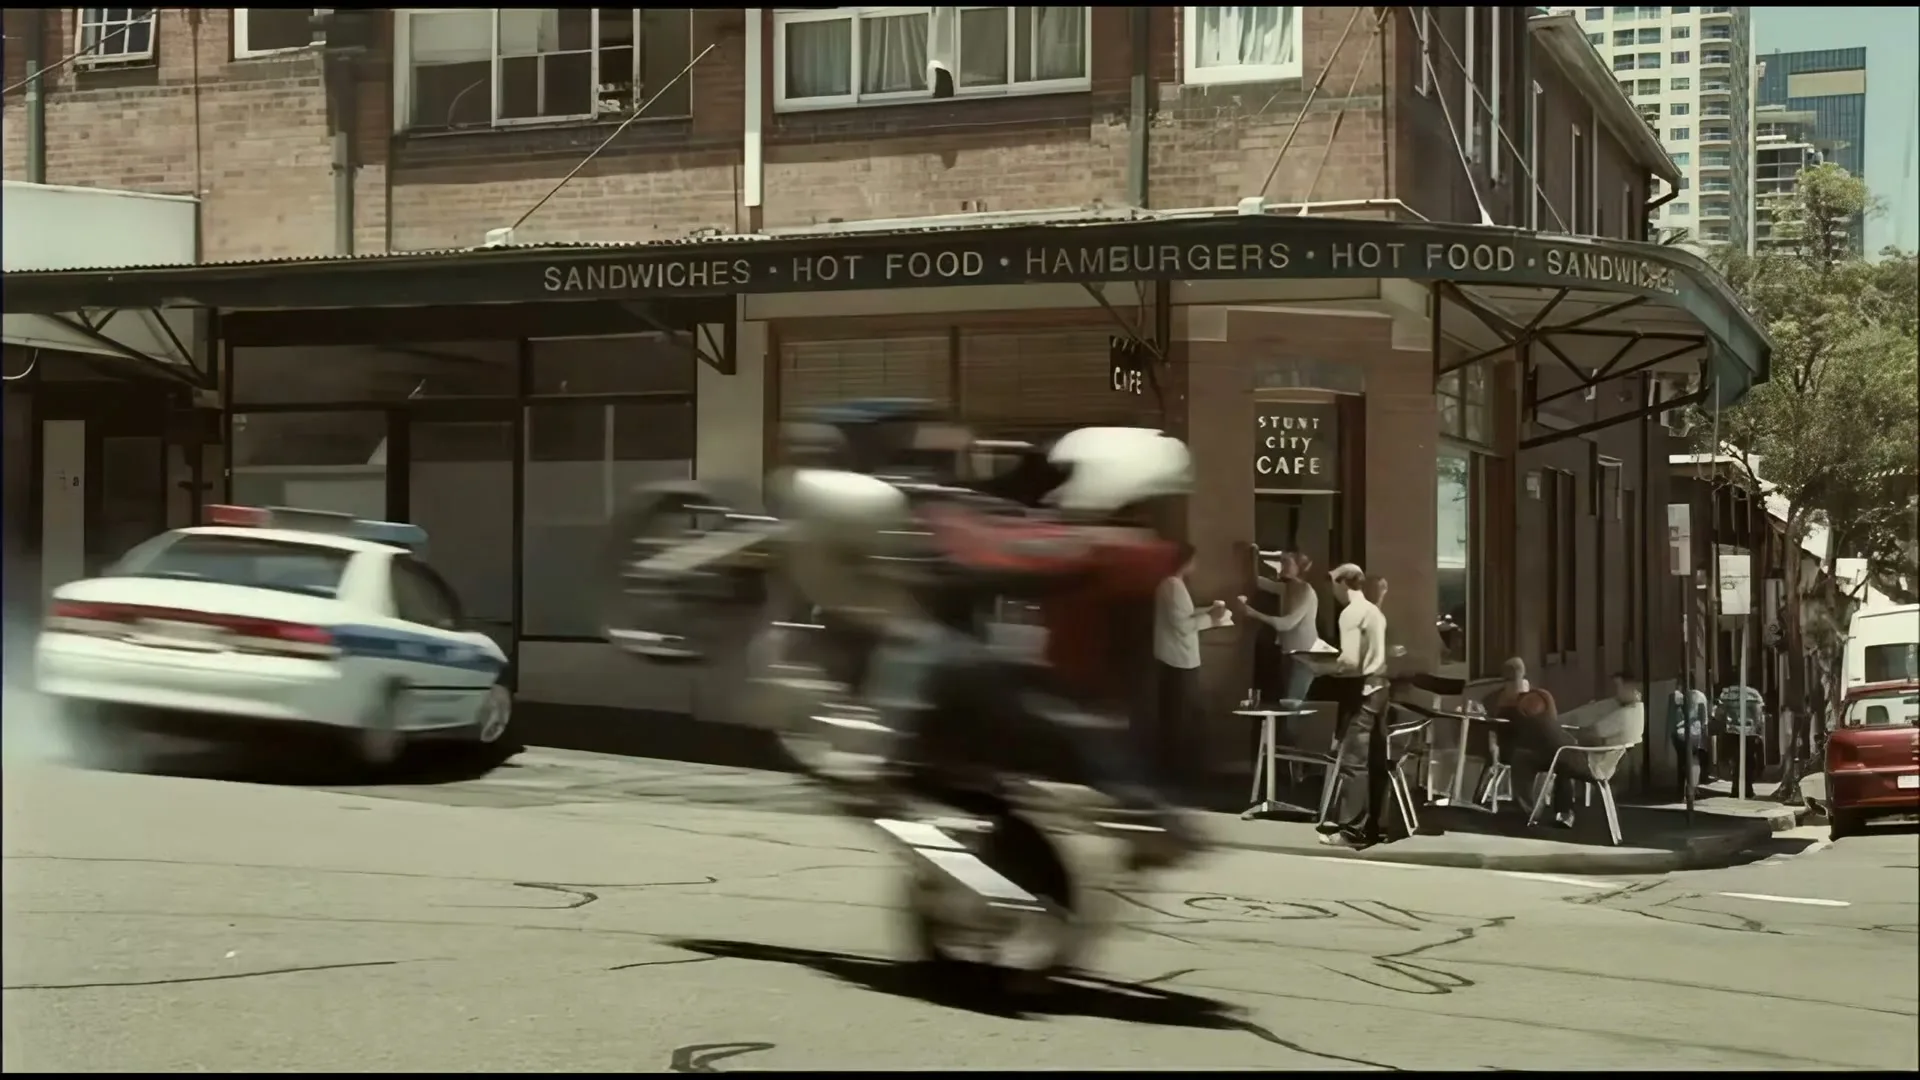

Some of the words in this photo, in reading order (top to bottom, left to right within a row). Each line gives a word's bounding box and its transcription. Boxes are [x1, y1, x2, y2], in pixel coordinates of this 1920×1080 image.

[543, 258, 752, 292] SANDWICHES
[792, 255, 862, 283] HOT
[885, 251, 985, 280] FOOD
[1025, 243, 1290, 276] HAMBURGERS
[1331, 241, 1406, 269] HOT
[1427, 243, 1516, 272] FOOD
[1258, 415, 1320, 430] STUNT
[1256, 455, 1321, 475] CAFE
